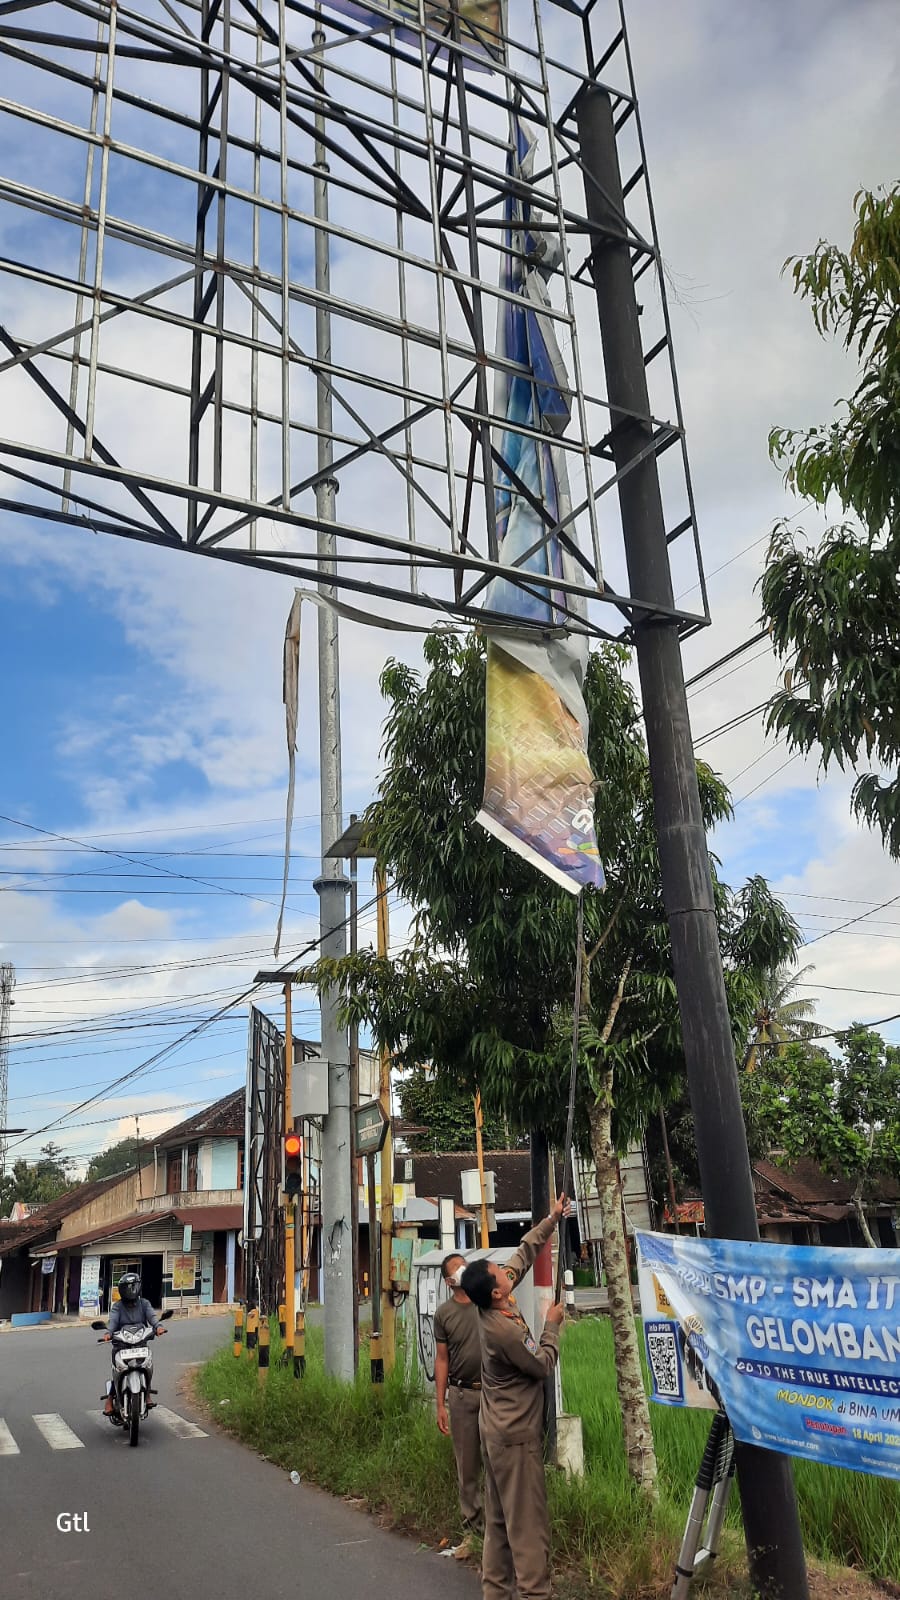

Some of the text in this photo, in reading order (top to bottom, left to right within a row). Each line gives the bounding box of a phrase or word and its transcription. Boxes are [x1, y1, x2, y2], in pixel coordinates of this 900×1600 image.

[713, 1272, 767, 1304] SMP
[792, 1276, 858, 1309] SMA
[866, 1276, 900, 1310] IT
[746, 1315, 900, 1362] GELOMBAN
[757, 1364, 771, 1376] TO
[775, 1367, 796, 1380] THE
[799, 1370, 830, 1385] TRUE
[833, 1374, 900, 1394] INTELLEC
[776, 1389, 834, 1411] MONDOK
[837, 1401, 846, 1414] di
[849, 1402, 878, 1419] BINA
[852, 1428, 862, 1440] 18
[863, 1430, 883, 1444] April
